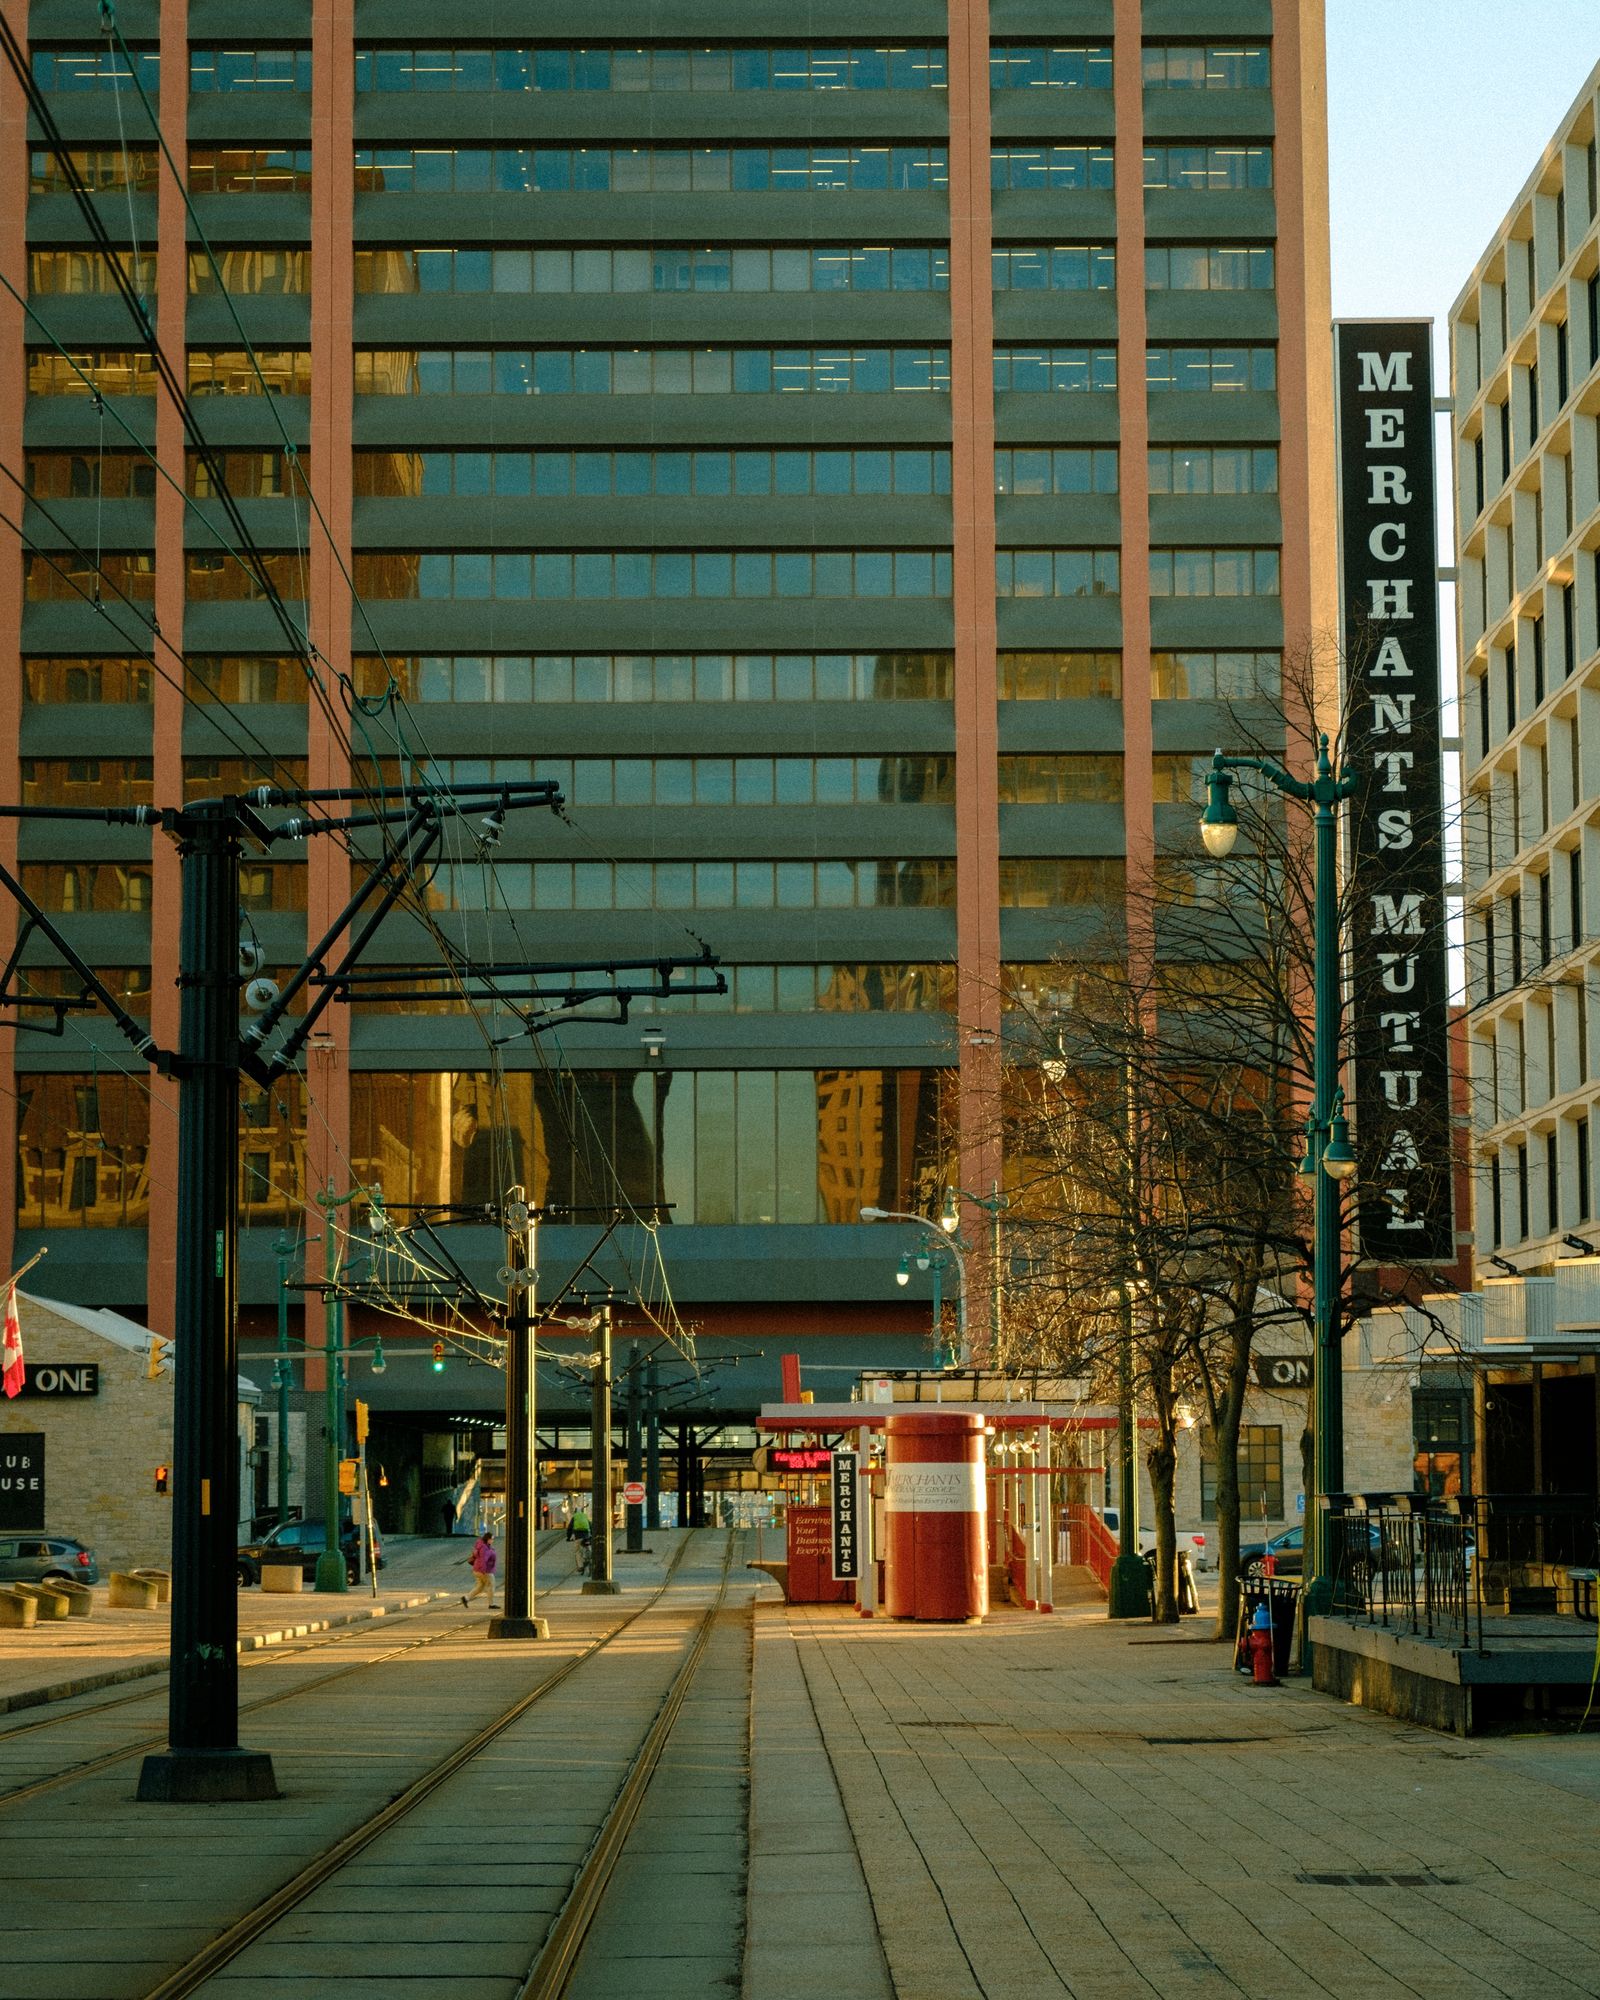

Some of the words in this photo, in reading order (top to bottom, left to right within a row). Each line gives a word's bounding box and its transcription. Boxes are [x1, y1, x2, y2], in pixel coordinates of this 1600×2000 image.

[1357, 351, 1415, 850] MERCHANTS
[1370, 893, 1425, 1230] MUTUAL
[35, 1369, 94, 1392] ONE
[0, 1456, 31, 1468] UB
[838, 1460, 852, 1572] MERCHANTS
[796, 1526, 817, 1535] Your
[796, 1546, 819, 1556] Every
